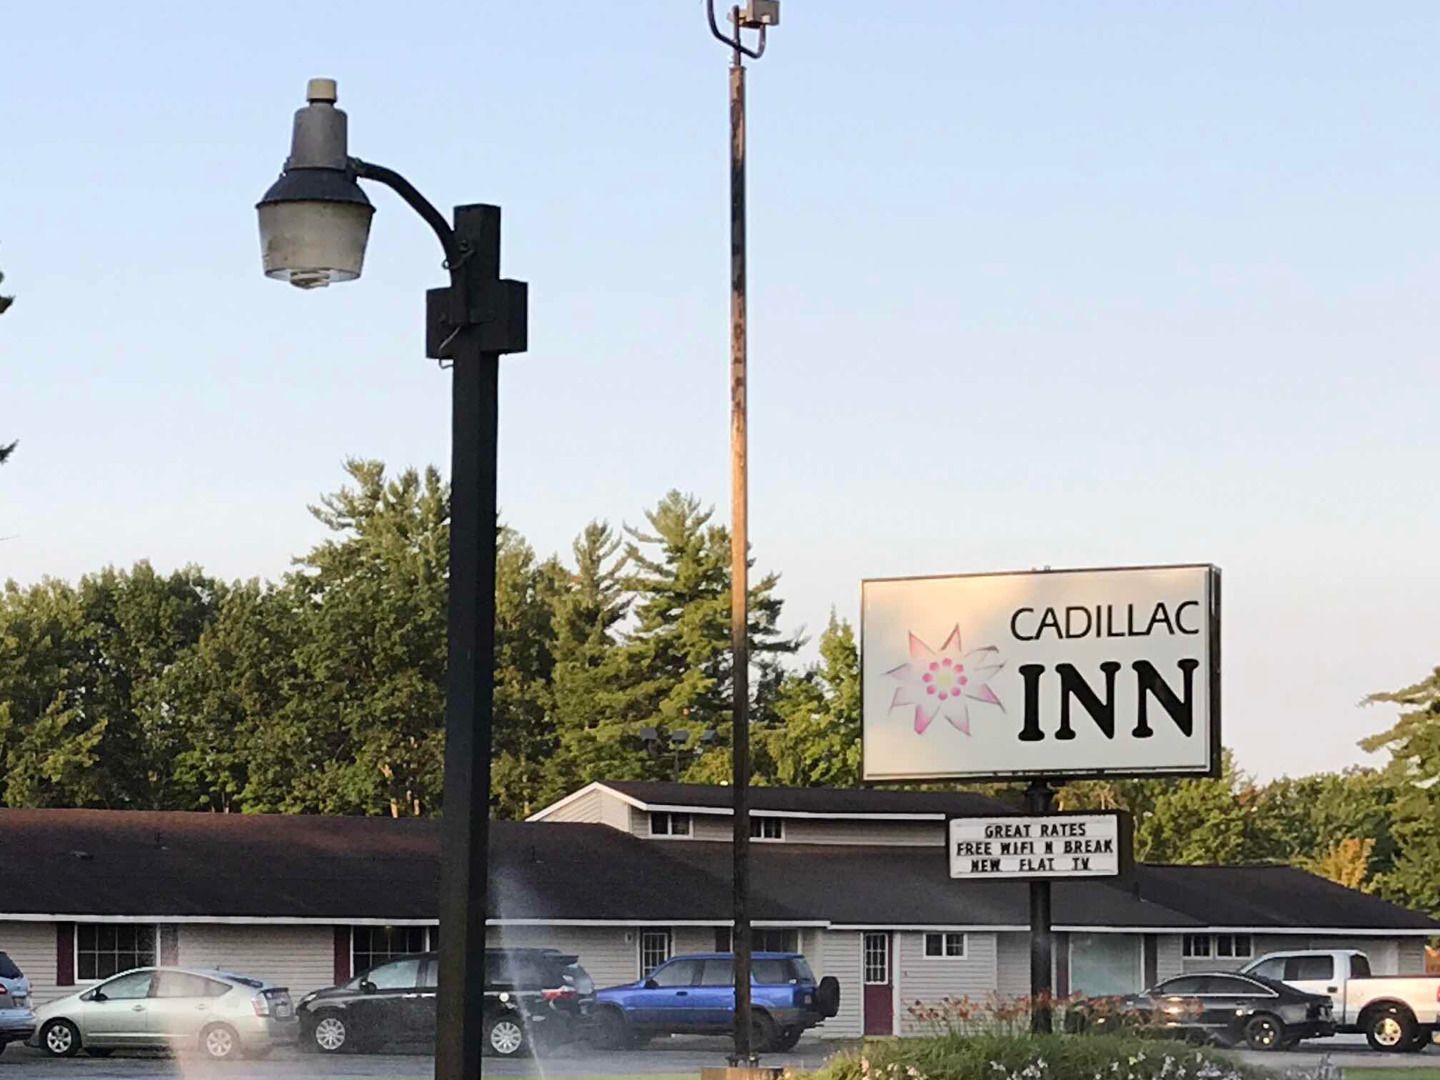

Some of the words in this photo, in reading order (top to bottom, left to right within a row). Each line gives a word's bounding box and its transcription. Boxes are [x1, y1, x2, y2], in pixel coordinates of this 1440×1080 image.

[1010, 601, 1200, 641] CADILLAC
[1018, 659, 1199, 742] INN
[985, 824, 1031, 838] GREAT
[1040, 823, 1086, 837] RATES
[957, 842, 992, 856] FREE
[1000, 841, 1035, 855] WIFI
[1044, 841, 1054, 854] N
[1063, 839, 1113, 854] BREAK
[971, 859, 1001, 872] NEW
[1019, 858, 1054, 871] FLAT
[1072, 857, 1090, 871] TV
